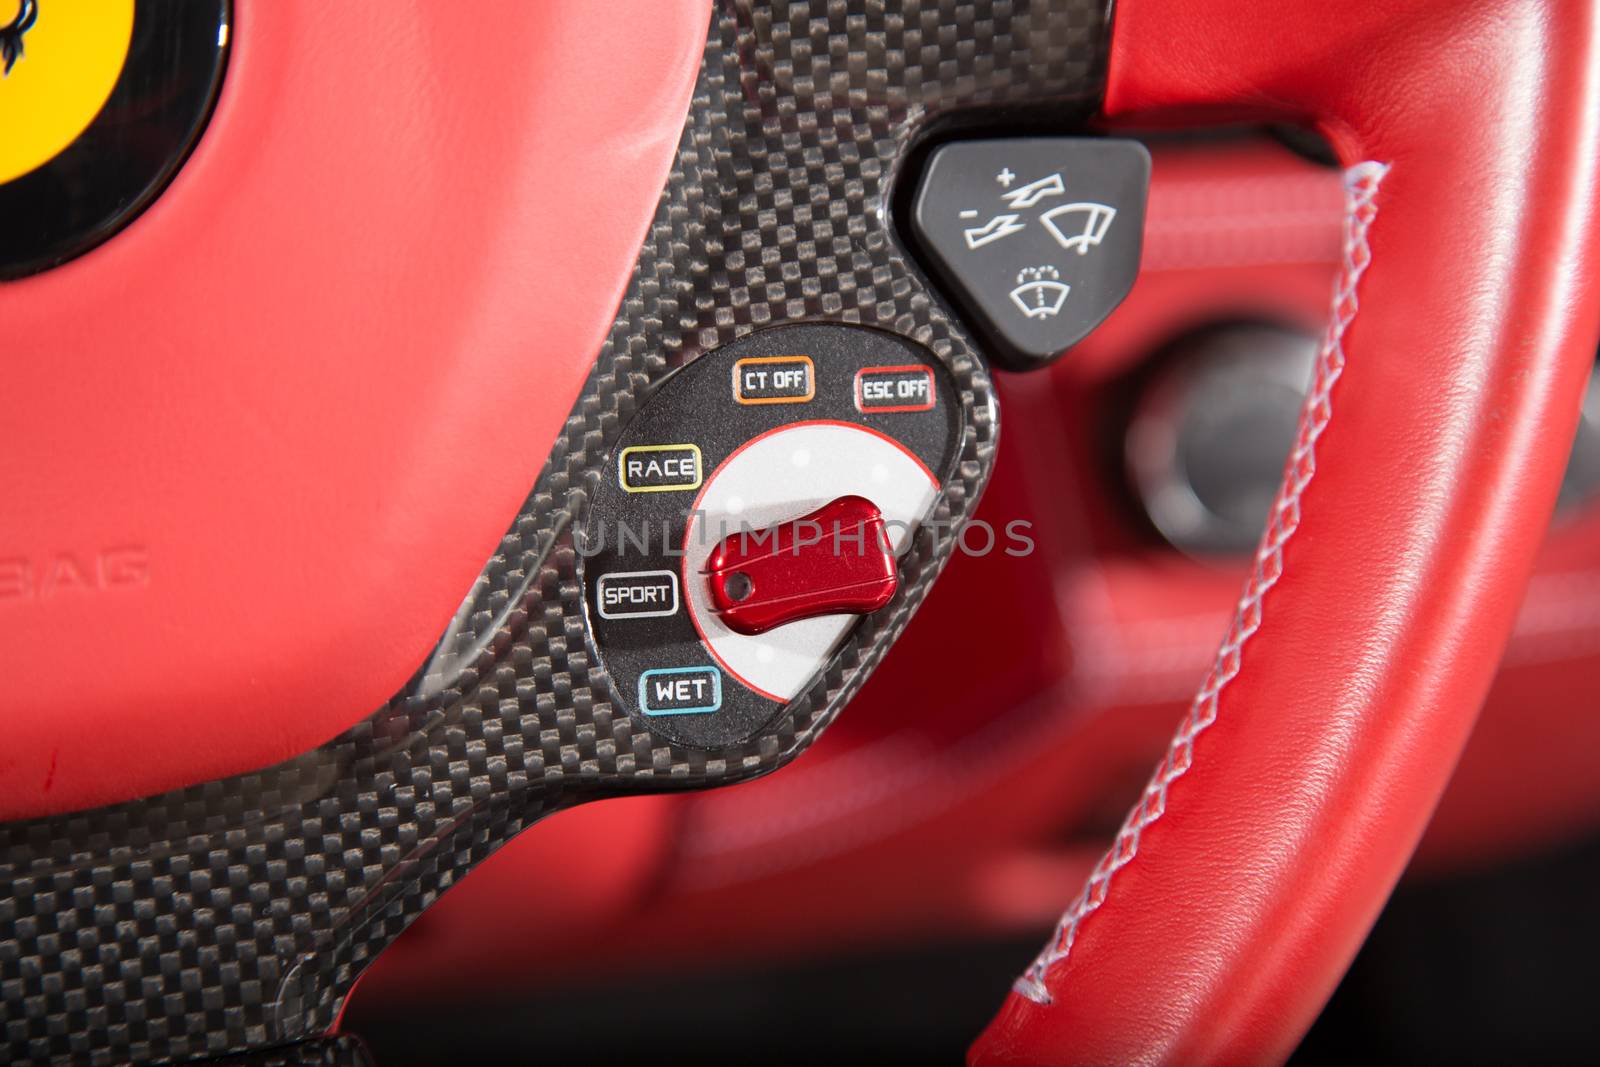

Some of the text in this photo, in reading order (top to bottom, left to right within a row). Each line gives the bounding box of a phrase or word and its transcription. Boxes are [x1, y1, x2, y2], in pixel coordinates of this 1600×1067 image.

[745, 370, 803, 390] CT OFF
[863, 379, 928, 399] ESC OFF
[628, 458, 695, 478] RACE
[605, 584, 670, 604] SPORT
[655, 679, 707, 701] WET
